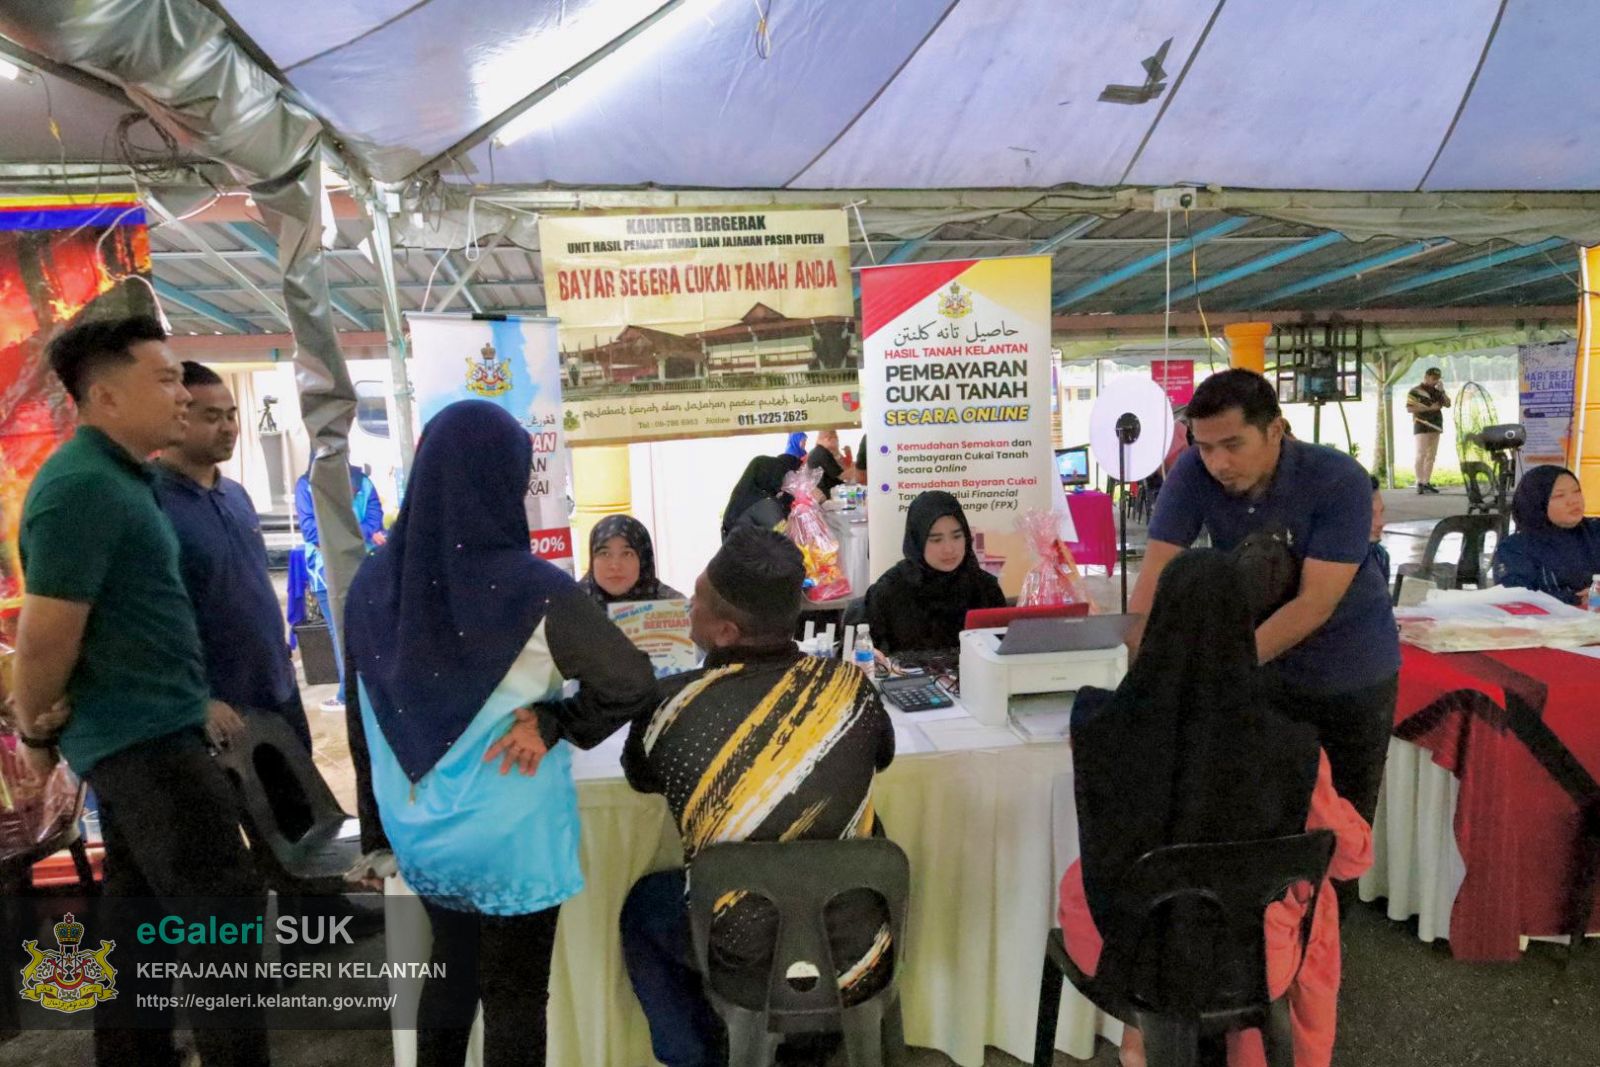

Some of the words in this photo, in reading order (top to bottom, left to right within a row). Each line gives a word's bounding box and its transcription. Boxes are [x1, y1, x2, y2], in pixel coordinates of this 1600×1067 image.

[626, 217, 691, 234] KAUNTER
[694, 215, 766, 233] BERGERAK
[567, 242, 590, 254] UNIT
[593, 240, 621, 252] HASIL
[700, 236, 720, 248] DAN
[722, 235, 762, 247] JAJAHAN
[764, 234, 793, 246] PASIR
[794, 233, 825, 245] PUTEH
[557, 269, 614, 301] BAYAR
[620, 264, 681, 298] SEGERA
[685, 262, 731, 293] CUKAI
[735, 261, 788, 291] TANAH
[795, 258, 838, 289] ANDA
[884, 346, 919, 359] HASIL
[922, 345, 962, 357] TANAH
[966, 343, 1028, 356] KELANTAN
[885, 360, 1028, 382] PEMBAYARAN
[885, 384, 950, 403] CUKAI
[956, 381, 1028, 401] TANAH
[738, 410, 782, 426] 011-1225
[783, 409, 808, 423] 2625
[885, 407, 958, 426] SECARA
[962, 405, 1030, 423] ONLINE
[897, 442, 959, 452] Kemudahan
[961, 440, 1009, 449] Semakan
[1011, 439, 1032, 447] dan
[897, 452, 962, 464] Pembayaran
[964, 451, 994, 460] Cukai
[995, 450, 1029, 459] Tanah
[897, 465, 932, 474] Secara
[934, 464, 967, 473] Online
[897, 480, 960, 490] Kemudahan
[962, 478, 1005, 489] Bayaran
[1006, 476, 1038, 485] Cukai
[972, 489, 1019, 498] Financial
[991, 499, 1018, 511] (FPX)
